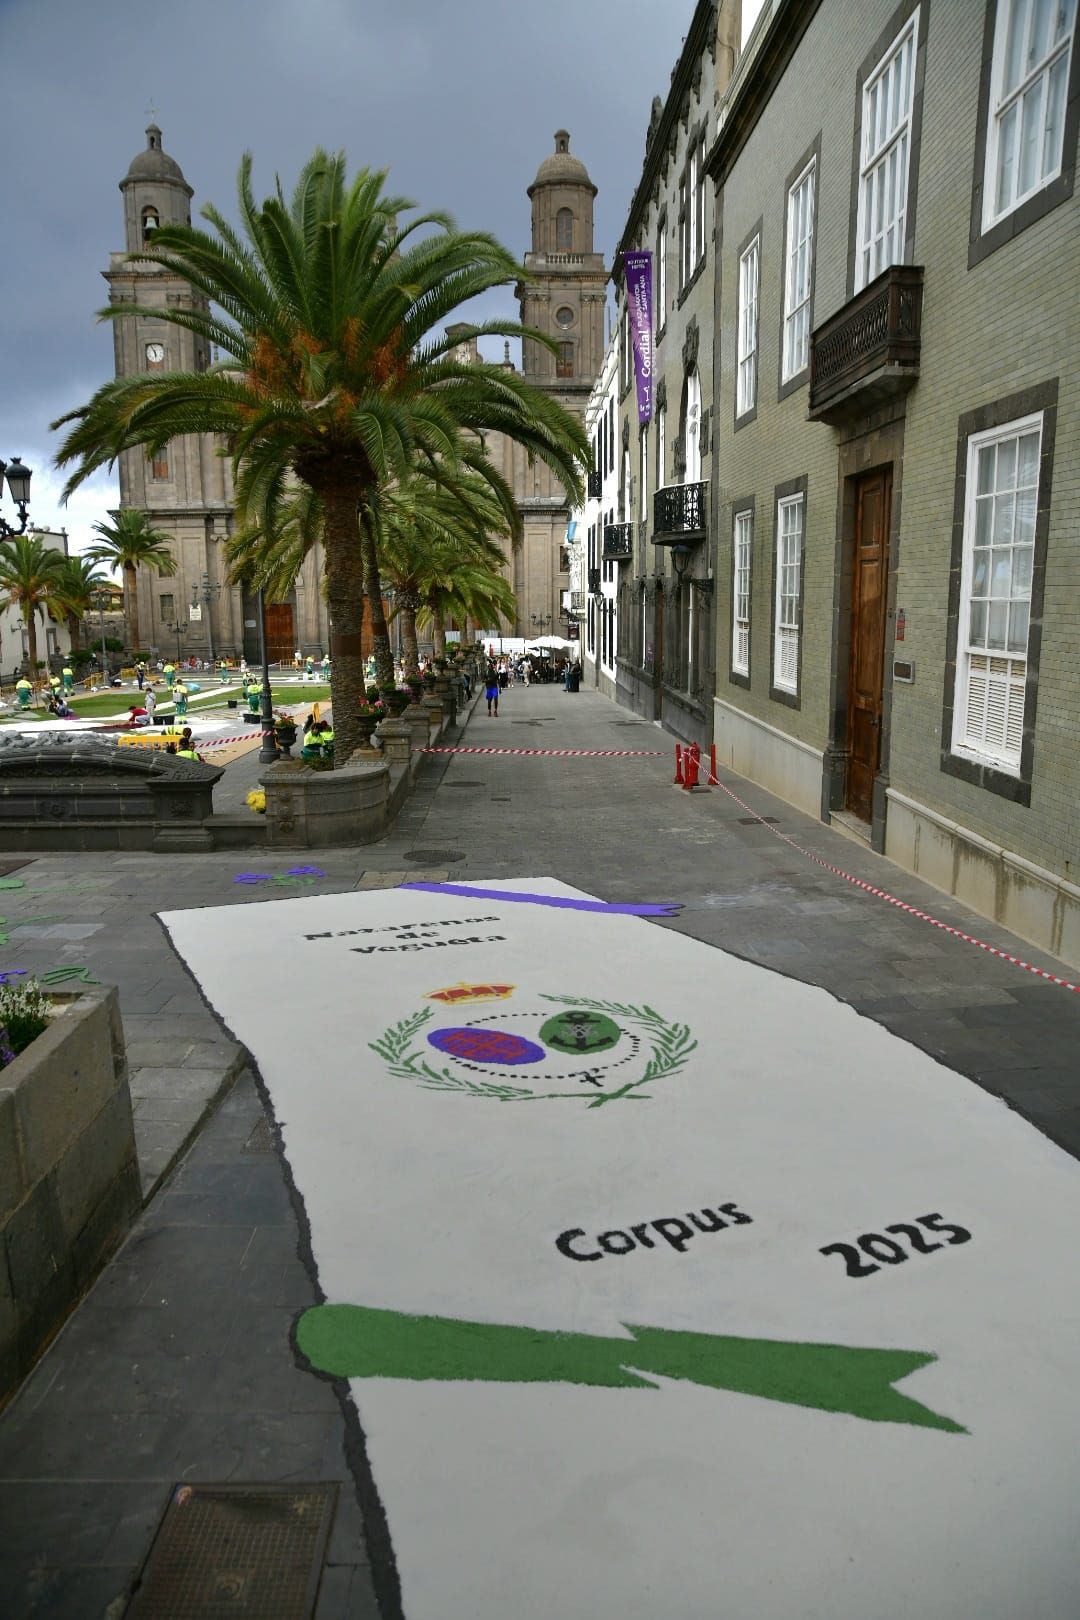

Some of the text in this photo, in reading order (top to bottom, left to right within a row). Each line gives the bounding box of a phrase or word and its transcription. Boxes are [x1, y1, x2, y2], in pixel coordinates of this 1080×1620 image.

[639, 329, 651, 378] Cordial
[304, 916, 500, 940] Nazarenos
[349, 935, 506, 953] Vegueta
[396, 931, 439, 939] de
[556, 1202, 753, 1262] Corpus
[819, 1213, 972, 1278] 2025
